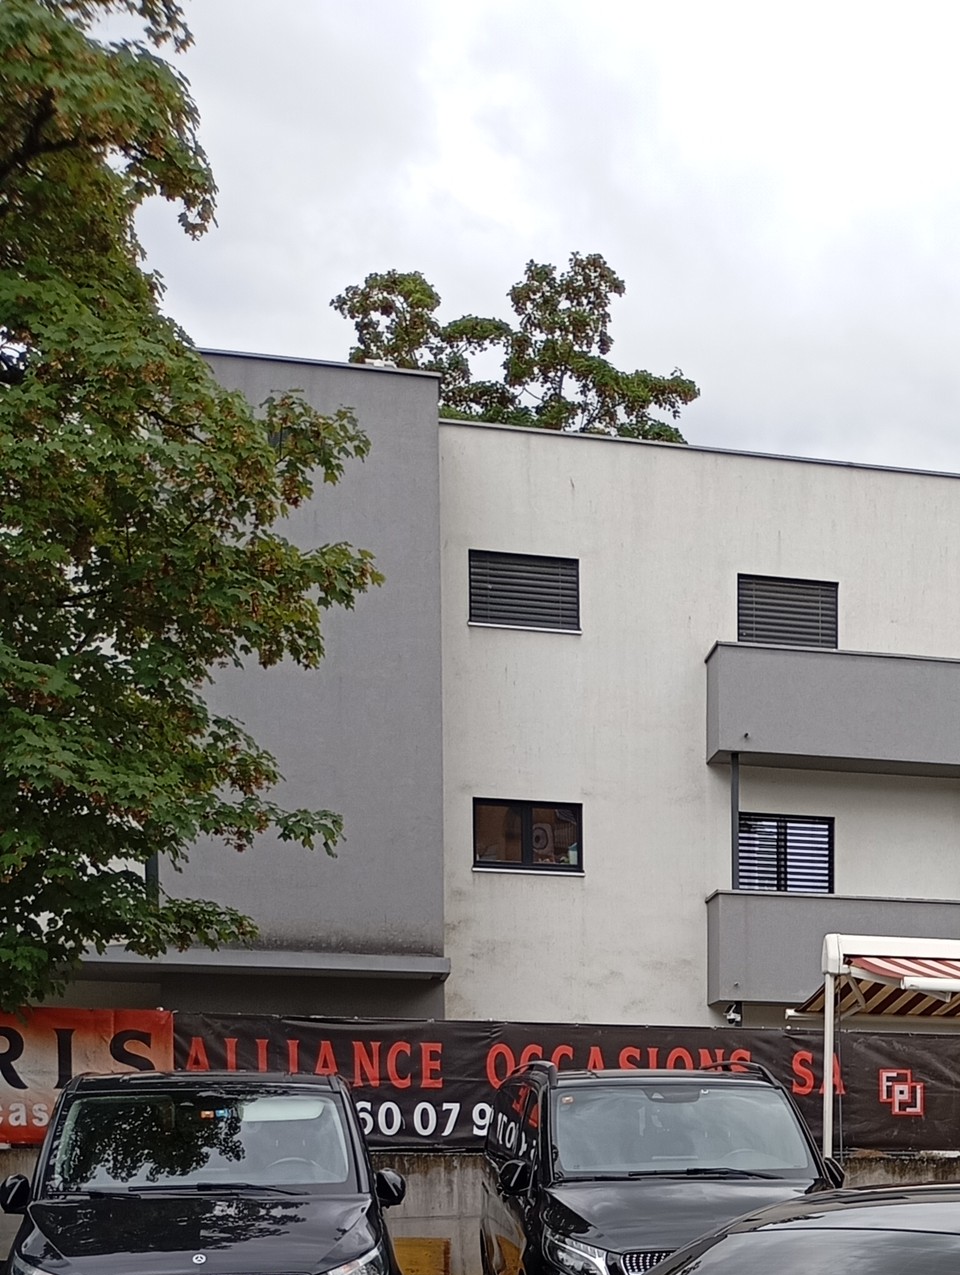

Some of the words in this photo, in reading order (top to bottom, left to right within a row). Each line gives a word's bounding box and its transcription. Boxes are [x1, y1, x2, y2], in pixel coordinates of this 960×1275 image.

[185, 1036, 444, 1089] ALLIANCE
[0, 1102, 49, 1127] as
[413, 1101, 460, 1136] 07
